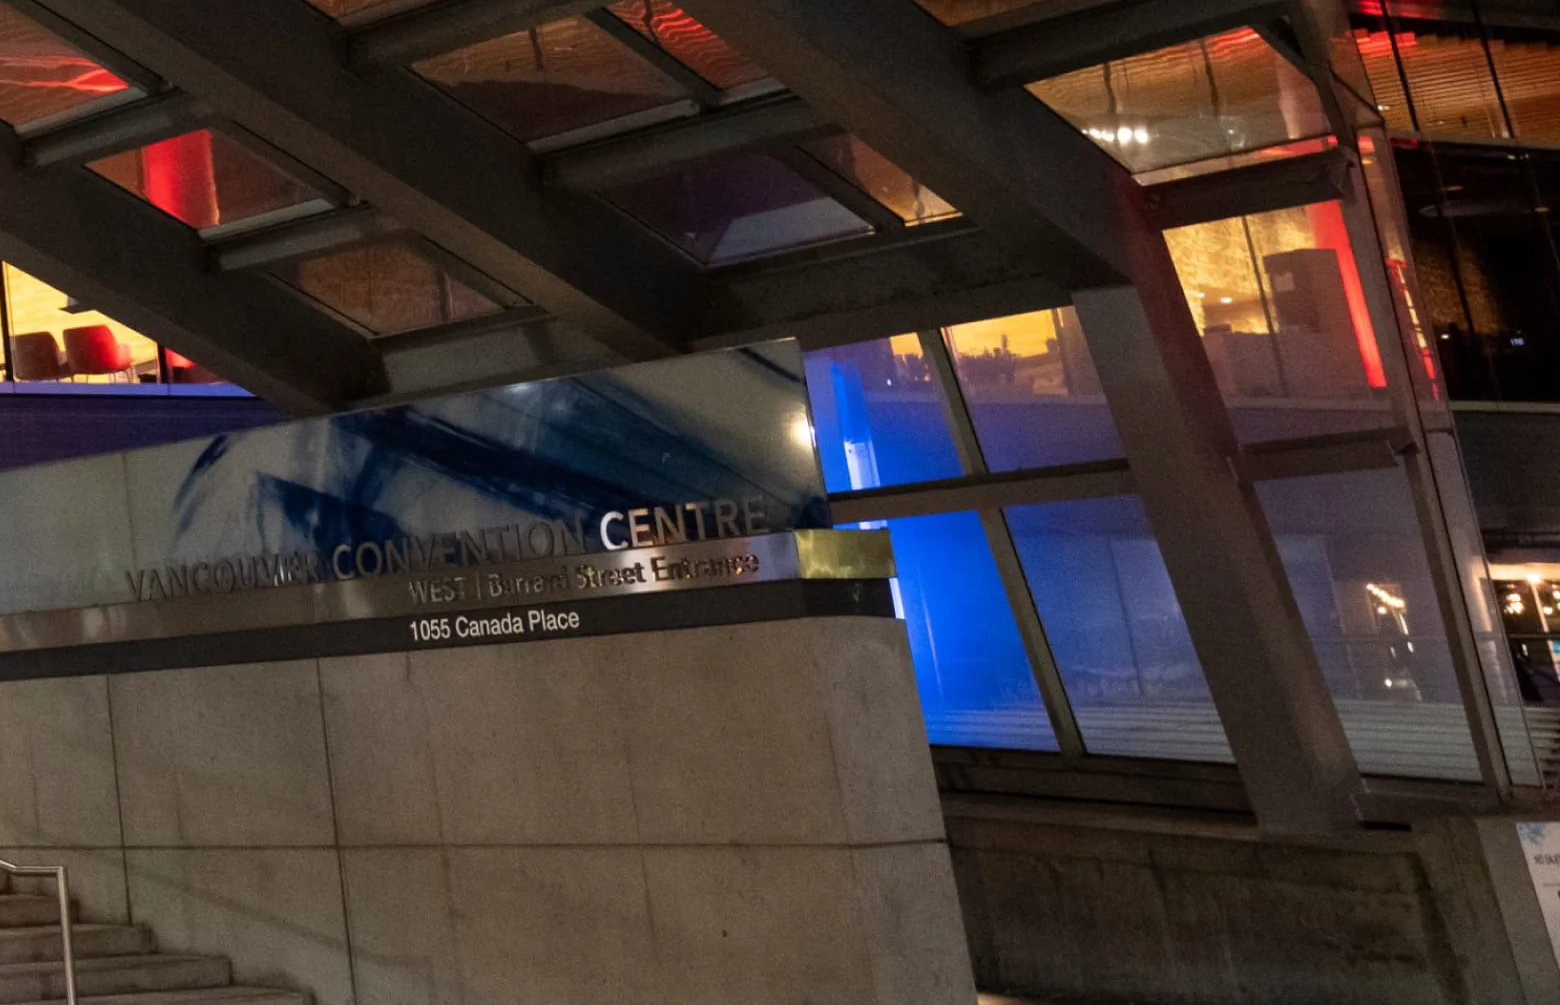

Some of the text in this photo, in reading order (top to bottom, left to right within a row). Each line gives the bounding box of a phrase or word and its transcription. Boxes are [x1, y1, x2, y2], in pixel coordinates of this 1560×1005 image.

[126, 494, 771, 603] VANCOUVER CONVENTION CENTRE
[409, 575, 466, 604] WEST
[577, 561, 647, 589] Street
[651, 553, 760, 583] Entrance
[410, 608, 580, 642] 1055 Canada Place
